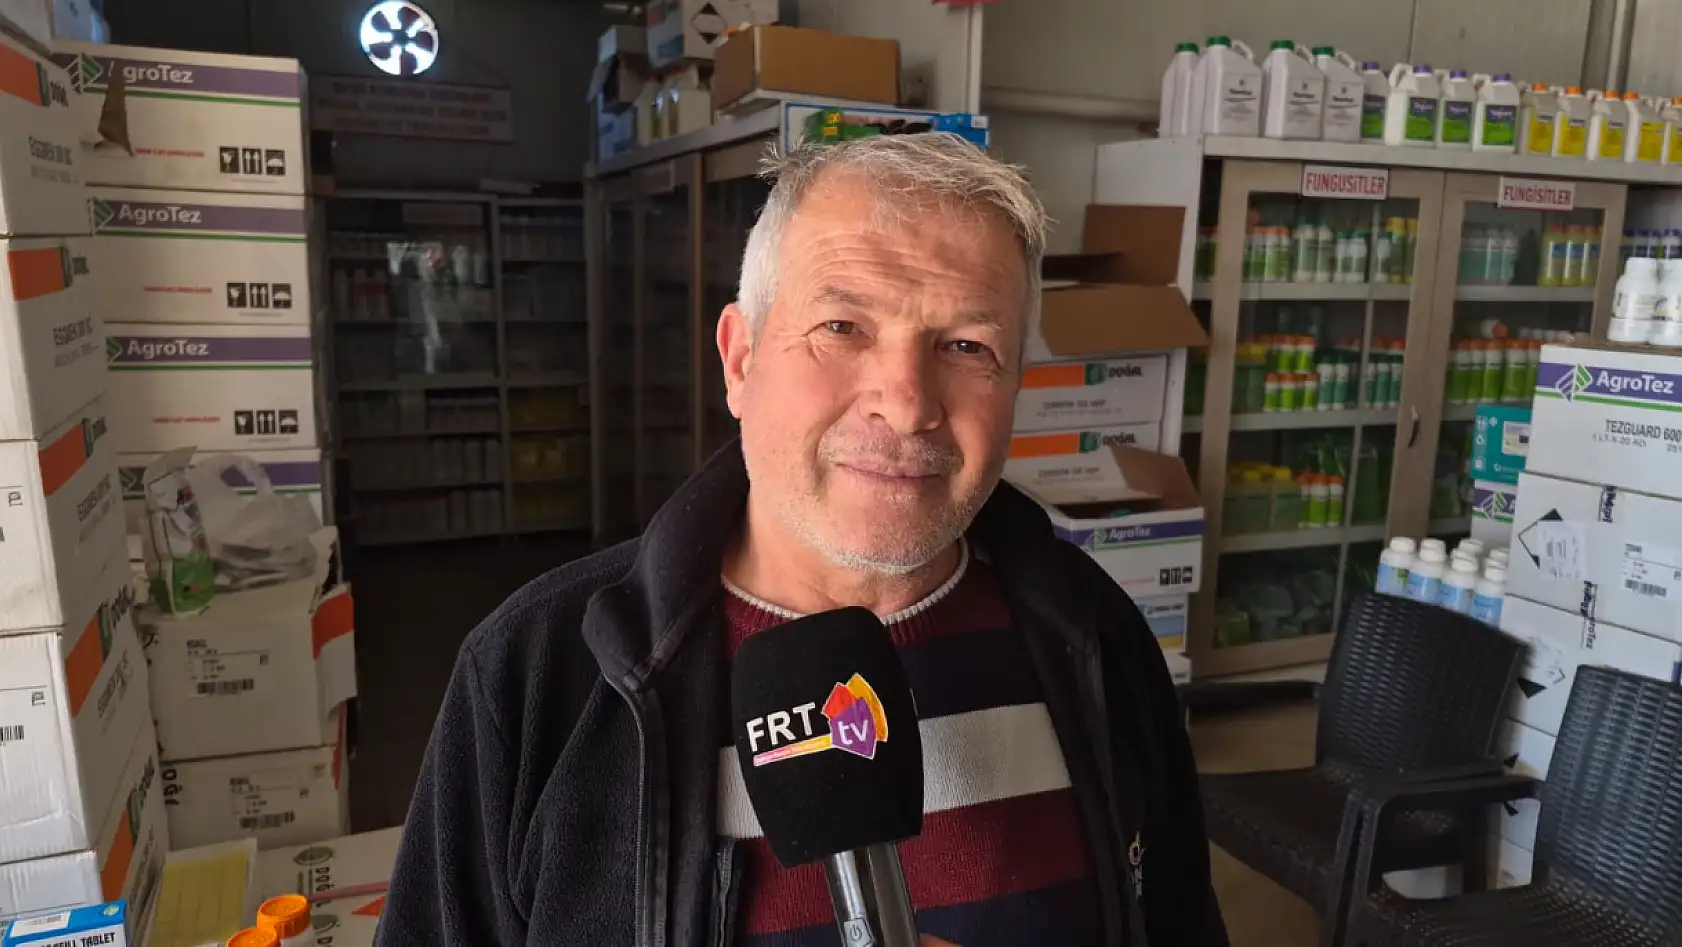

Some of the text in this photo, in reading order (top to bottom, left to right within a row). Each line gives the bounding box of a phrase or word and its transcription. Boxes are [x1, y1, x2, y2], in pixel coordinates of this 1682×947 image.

[107, 61, 195, 84] groTez
[118, 202, 203, 225] AgroTez
[127, 339, 210, 360] AgroTez
[1595, 369, 1676, 394] AgroTez
[1605, 419, 1661, 439] TEZGUARD
[746, 702, 816, 752] FRT
[837, 719, 868, 745] tv
